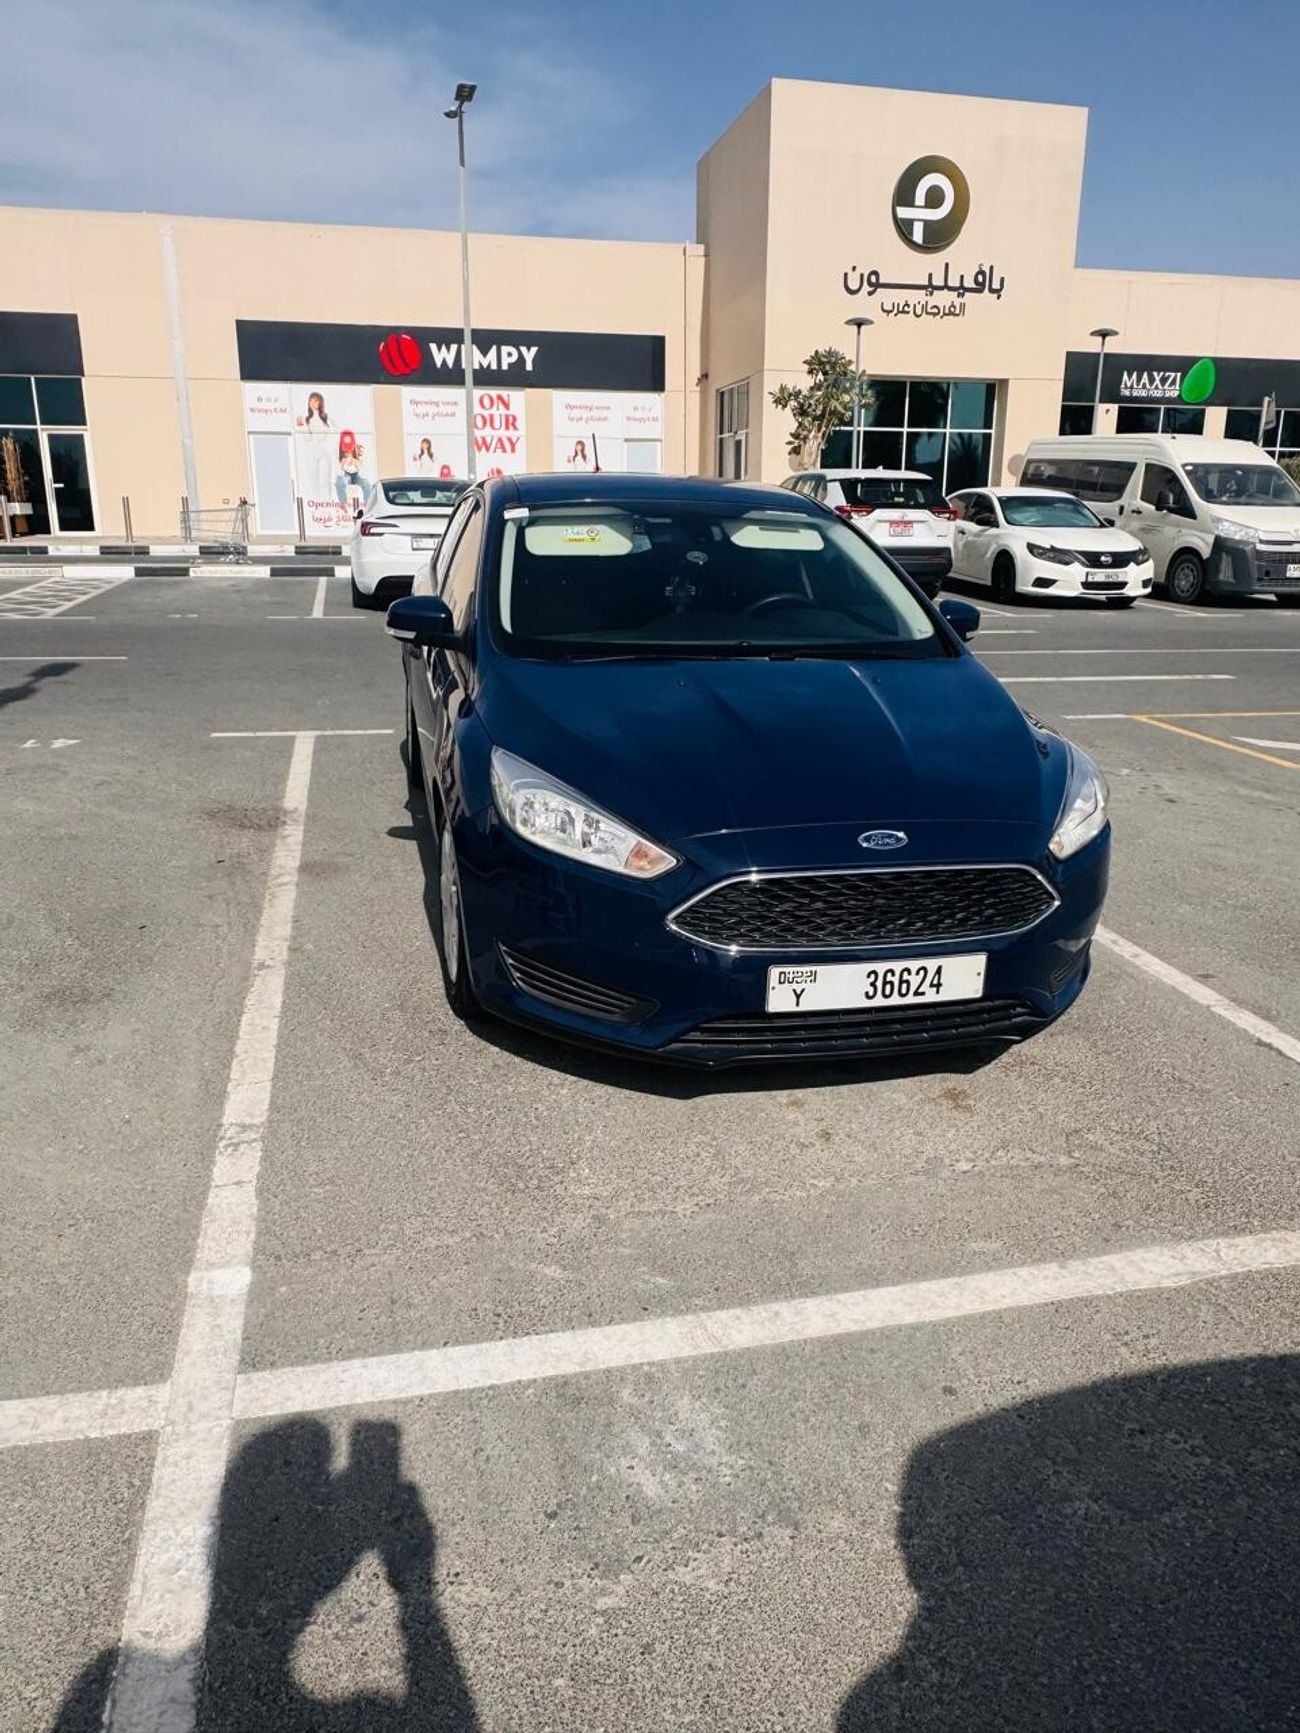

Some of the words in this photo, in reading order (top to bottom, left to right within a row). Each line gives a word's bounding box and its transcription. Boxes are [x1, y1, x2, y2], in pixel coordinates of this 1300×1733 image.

[880, 299, 911, 317] غرب
[913, 300, 966, 319] الفرجان
[428, 342, 539, 371] WIMPY
[1120, 370, 1182, 389] MAXZI
[479, 393, 511, 411] ON
[473, 413, 519, 431] OUR
[473, 436, 520, 454] WAY
[792, 988, 805, 1007] Y
[864, 965, 943, 1000] 36624
